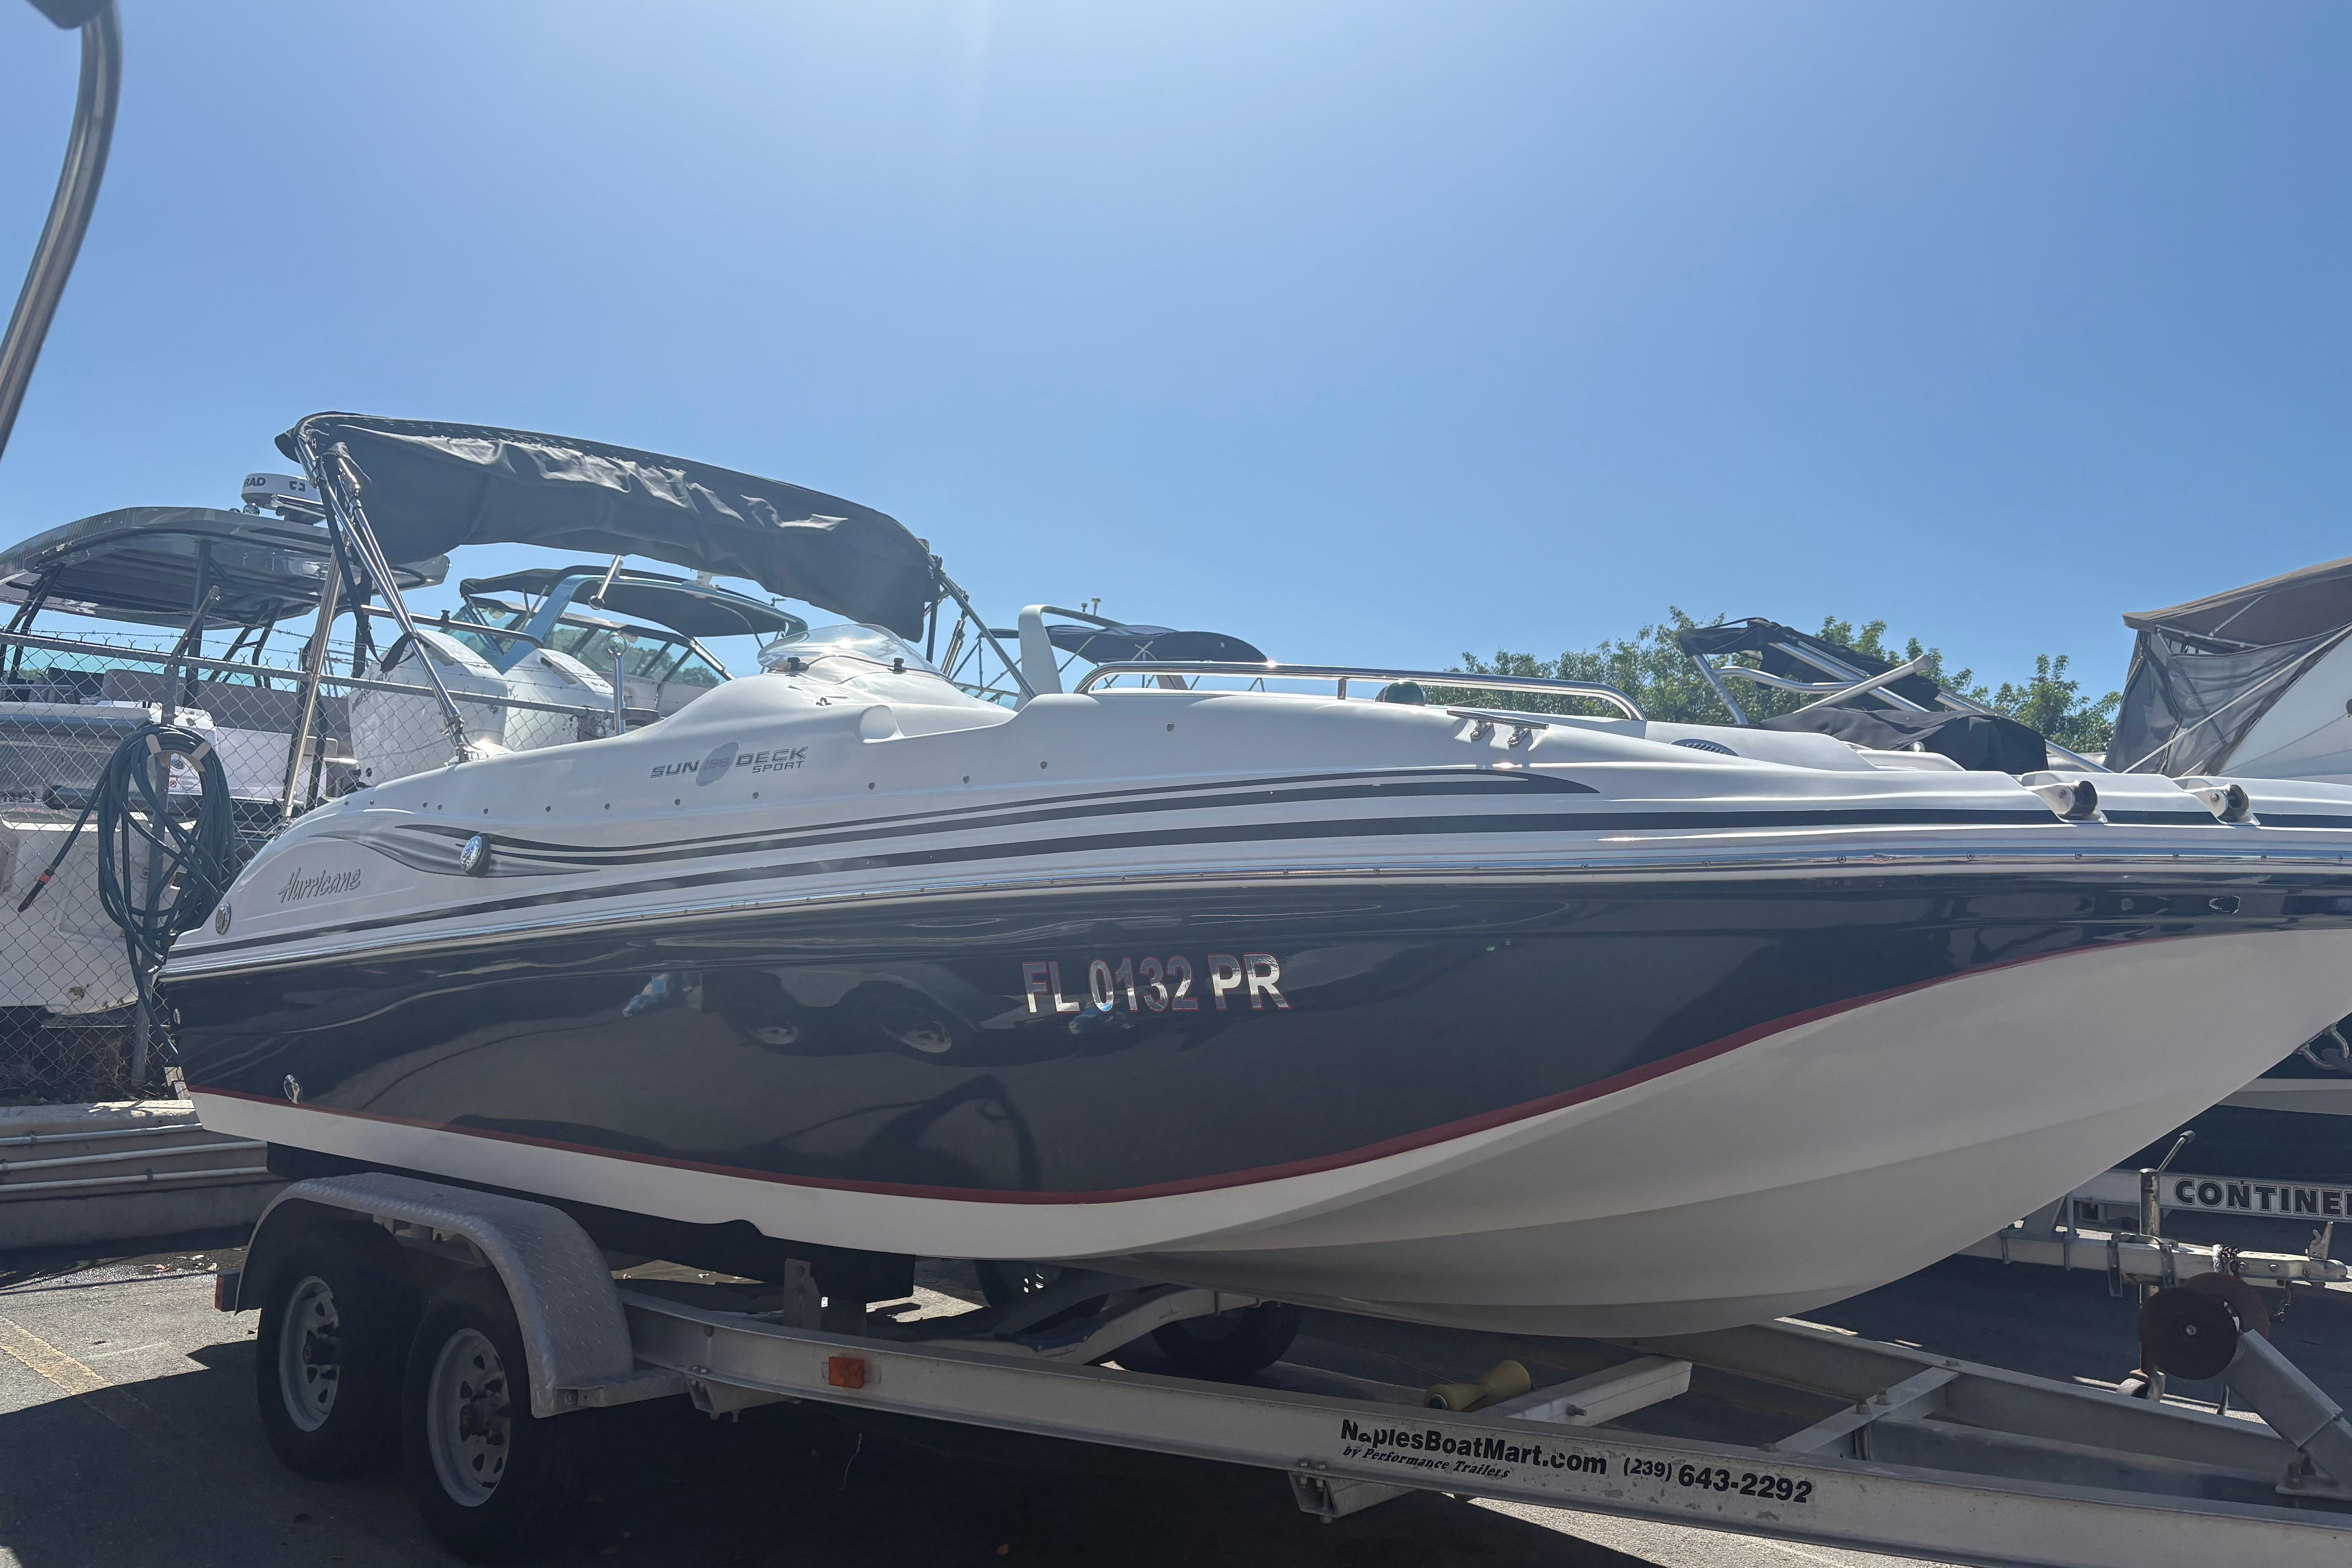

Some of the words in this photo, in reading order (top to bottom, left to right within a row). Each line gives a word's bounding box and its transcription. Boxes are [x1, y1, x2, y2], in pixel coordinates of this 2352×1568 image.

[650, 759, 700, 778] SUN
[735, 746, 808, 767] DECK
[752, 761, 805, 773] SPORT
[278, 867, 361, 903] Hurricane
[1022, 961, 1080, 1013] FL
[1089, 956, 1199, 1012] 0132
[1207, 952, 1291, 1011] PR
[1341, 1419, 1606, 1475] NaplesBoatMart.com
[1624, 1457, 1672, 1482] (239)
[1678, 1464, 1812, 1503] 643-2292
[1342, 1445, 1360, 1458] by
[1362, 1448, 1450, 1470] Performance
[1453, 1461, 1510, 1478] Trailers
